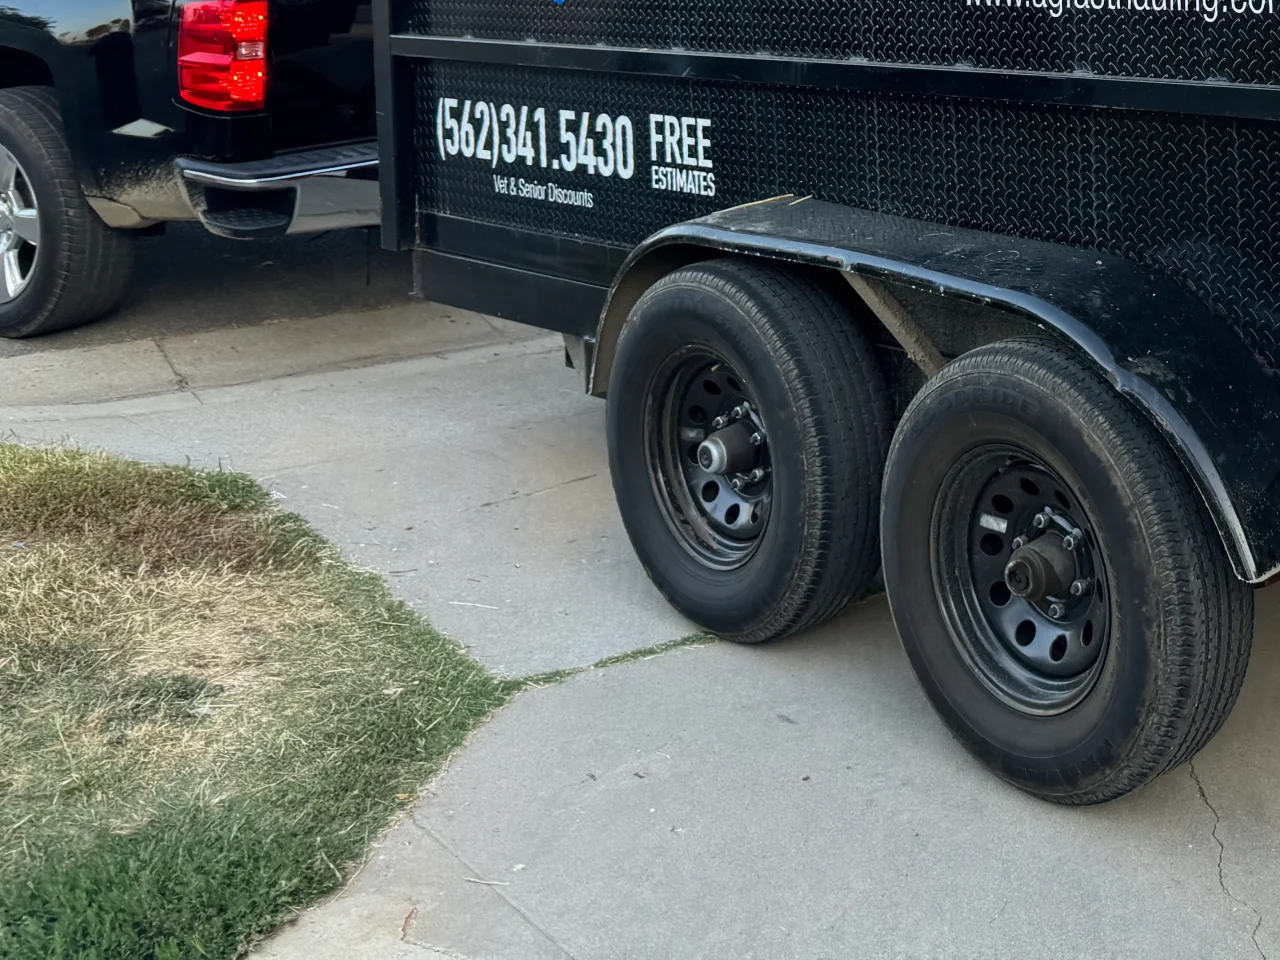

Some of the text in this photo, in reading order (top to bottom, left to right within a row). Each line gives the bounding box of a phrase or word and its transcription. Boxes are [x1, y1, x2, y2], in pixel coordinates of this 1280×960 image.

[436, 96, 636, 180] (562)341.5430
[649, 113, 713, 169] FREE
[493, 174, 594, 209] Vet & Senior Discounts
[651, 165, 716, 197] ESTIMATES
